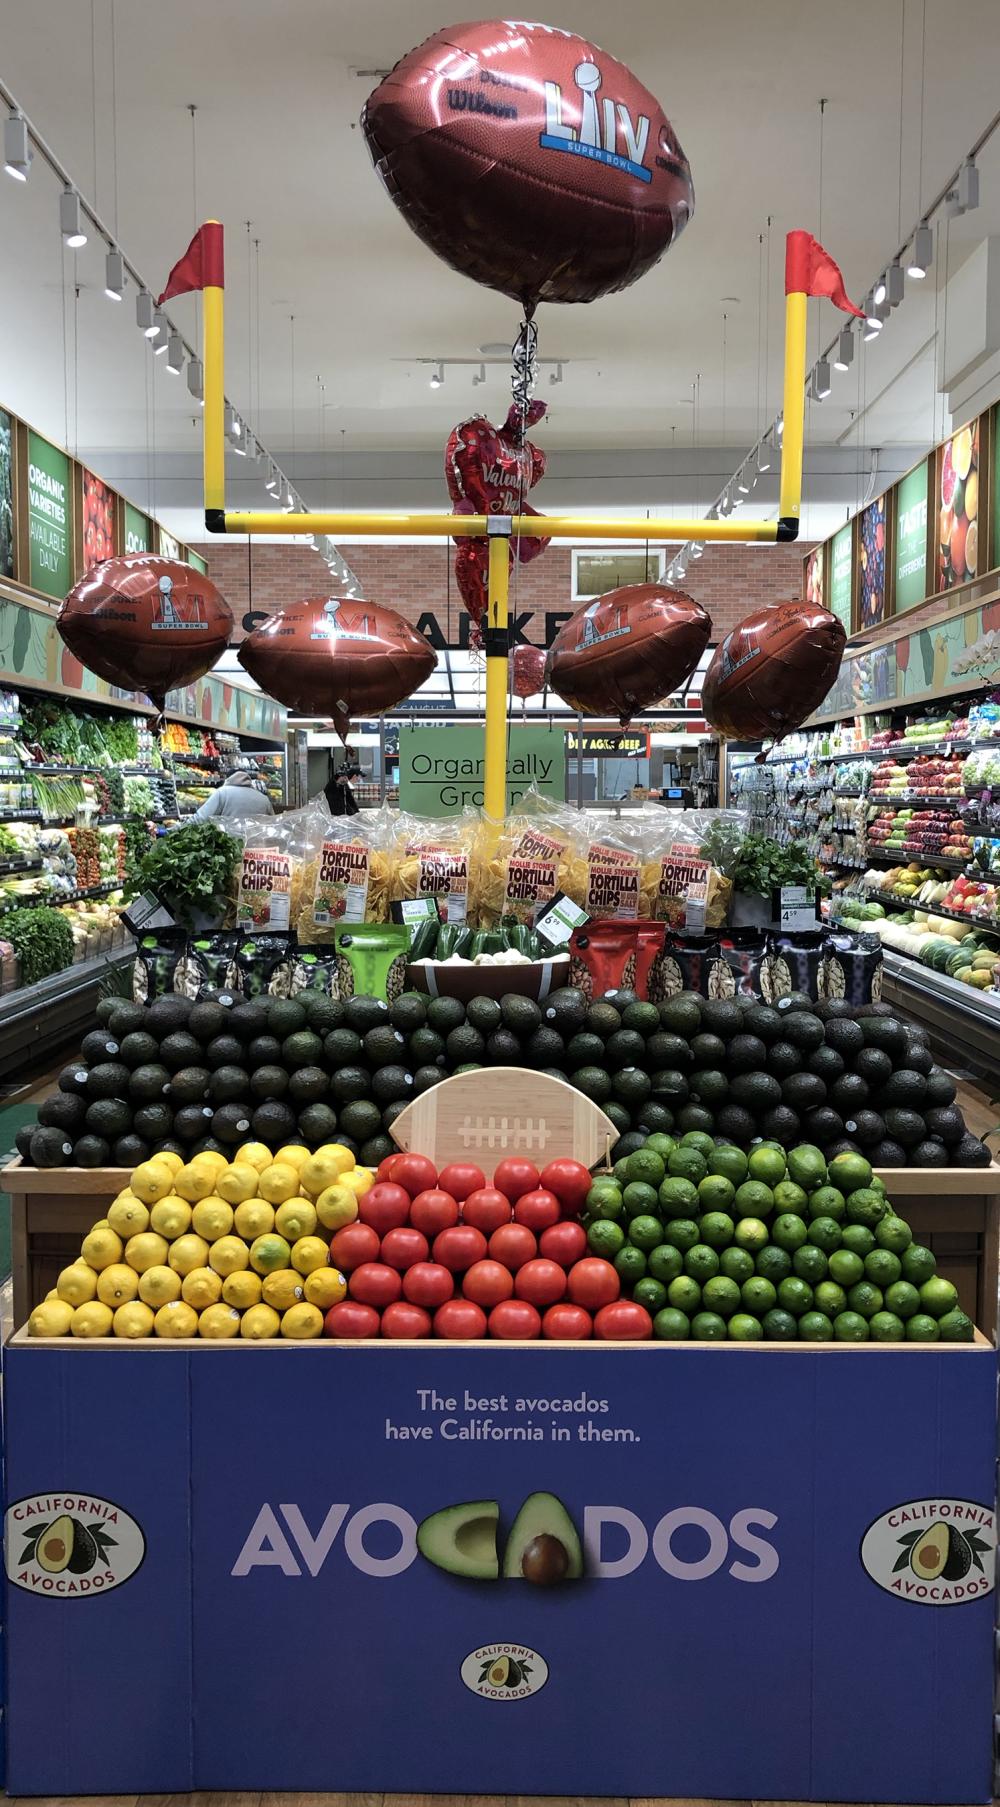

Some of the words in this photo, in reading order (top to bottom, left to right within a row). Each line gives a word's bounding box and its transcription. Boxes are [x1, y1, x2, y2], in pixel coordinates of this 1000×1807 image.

[567, 141, 602, 159] SUPER
[606, 154, 632, 172] BOWL
[29, 463, 65, 503] ORGANIC
[29, 487, 66, 525] VARIETIES
[899, 499, 927, 541] TASTE
[31, 520, 66, 556] AVAILABLE
[39, 547, 59, 573] DAILY
[604, 628, 625, 640] BOWL
[323, 842, 344, 852] MOLLIE
[346, 845, 369, 855] STONE'S
[590, 845, 610, 856] MOLLIE
[672, 844, 692, 853] MOLLIE
[243, 858, 290, 878] TORTILLA
[322, 849, 368, 870] TORTILLA
[420, 860, 467, 878] TORTILLA
[509, 860, 532, 869] MOLLIE
[532, 861, 556, 871] STONE'S
[684, 860, 709, 870] STONE'S
[320, 865, 351, 884] CHIPS
[508, 867, 555, 887] TORTILLA
[591, 866, 613, 875] MOLLIE
[614, 868, 639, 877] STONE'S
[661, 863, 708, 885] TORTILLA
[241, 873, 273, 892] CHIPS
[420, 875, 451, 893] CHIPS
[507, 882, 538, 901] CHIPS
[590, 873, 638, 892] TORTILLA
[658, 878, 690, 898] CHIPS
[588, 889, 620, 907] CHIPS
[416, 1389, 457, 1411] The
[464, 1390, 508, 1412] best
[515, 1391, 610, 1413] avocados
[385, 1418, 433, 1440] have
[440, 1418, 544, 1441] California
[551, 1420, 571, 1442] in
[578, 1420, 641, 1442] them.
[13, 1498, 118, 1524] CALIFORNIA
[888, 1504, 993, 1529] CALIFORNIA
[17, 1570, 115, 1592] AVOCADOS
[891, 1577, 989, 1600] AVOCADOS
[474, 1646, 535, 1661] CALIFORNIA
[477, 1685, 532, 1698] AVOCADOS
